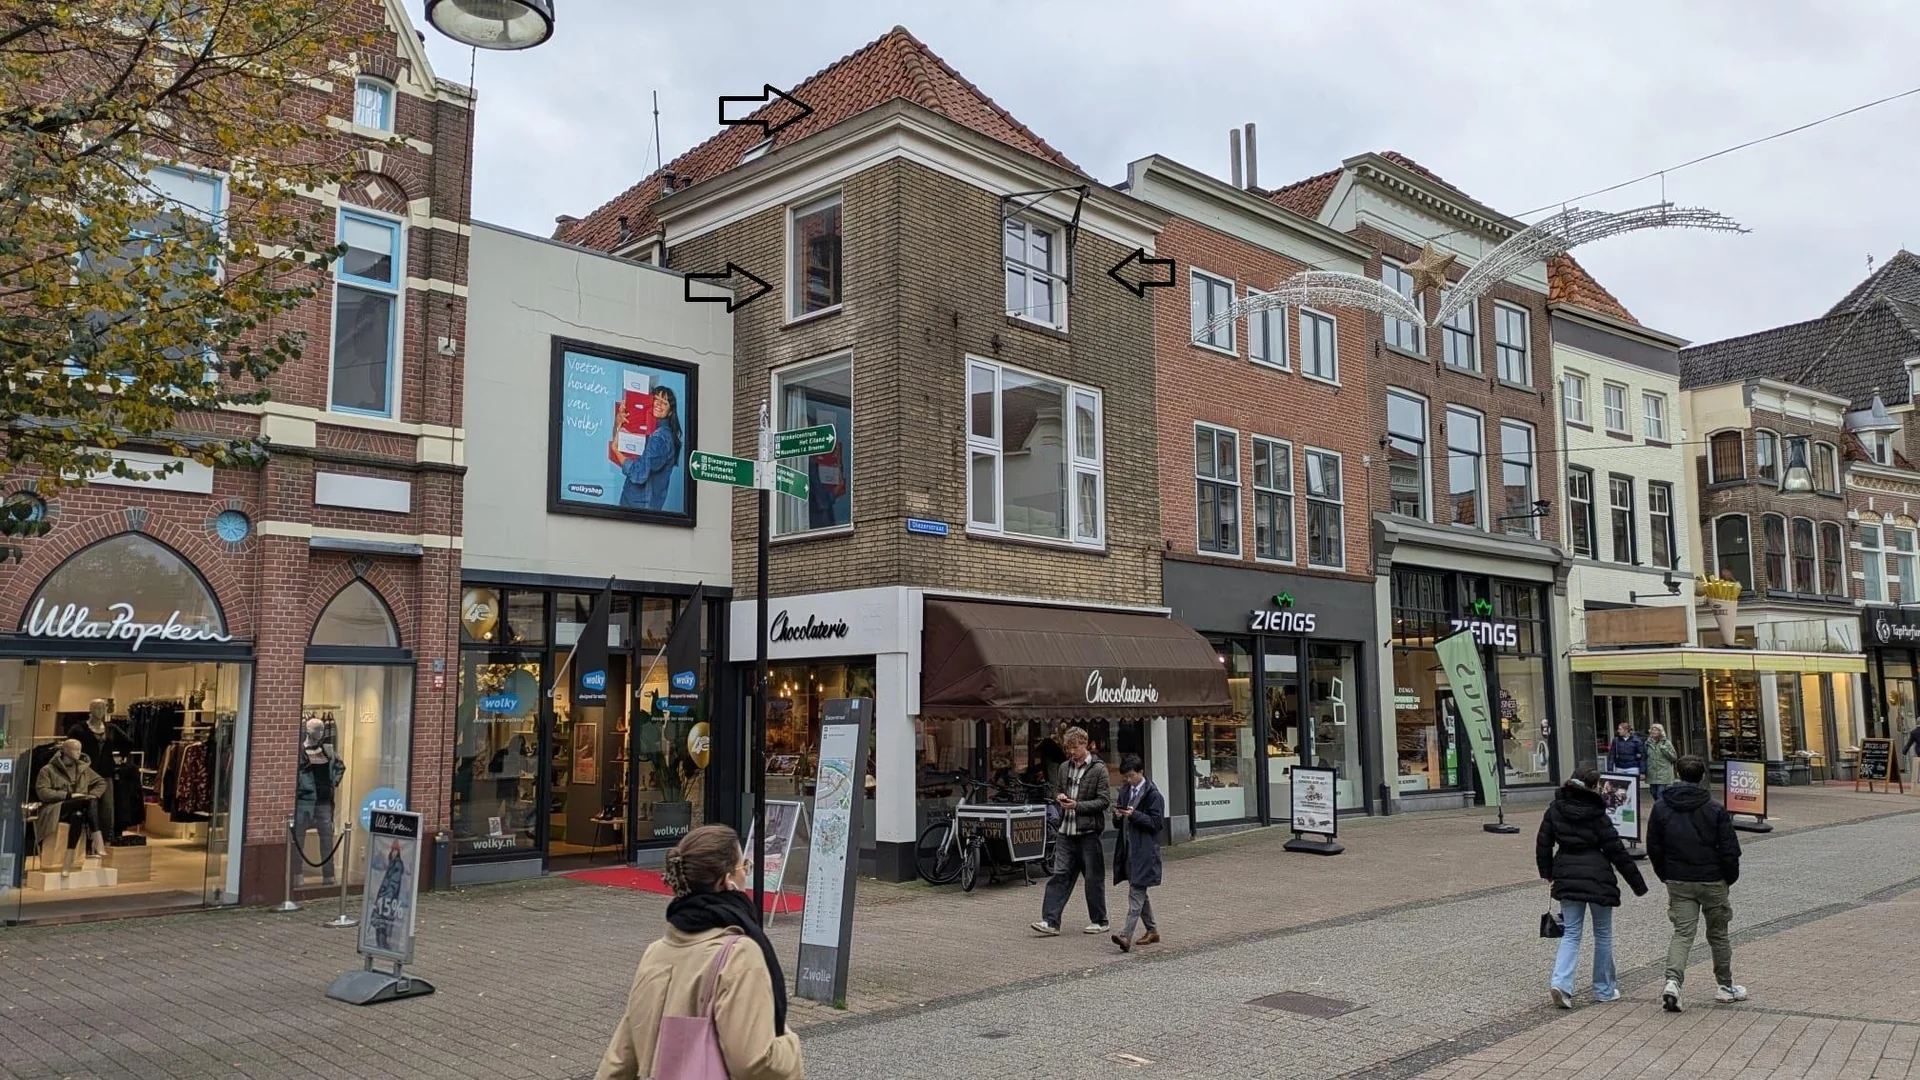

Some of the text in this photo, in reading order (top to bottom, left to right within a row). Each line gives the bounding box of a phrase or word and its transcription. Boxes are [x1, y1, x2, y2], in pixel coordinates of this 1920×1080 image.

[567, 357, 606, 376] Voeten
[567, 372, 609, 395] houden
[567, 399, 591, 411] van
[781, 431, 817, 441] Winkelcentrum
[701, 470, 736, 481] Provinciehuis
[570, 485, 602, 495] wolkyshop
[29, 598, 232, 651] Ulla Popken
[770, 610, 849, 642] Chocolaterie
[1252, 610, 1316, 632] ZIENGS
[585, 675, 605, 686] wolky
[676, 677, 694, 686] wolky
[1085, 669, 1159, 704] Chocolaterie
[485, 698, 518, 710] wolky
[1730, 775, 1760, 789] 50%
[652, 825, 689, 837] wolky.nl
[1013, 828, 1042, 844] BORREL
[473, 837, 516, 850] wolky.nl
[802, 967, 831, 983] Zwolle
